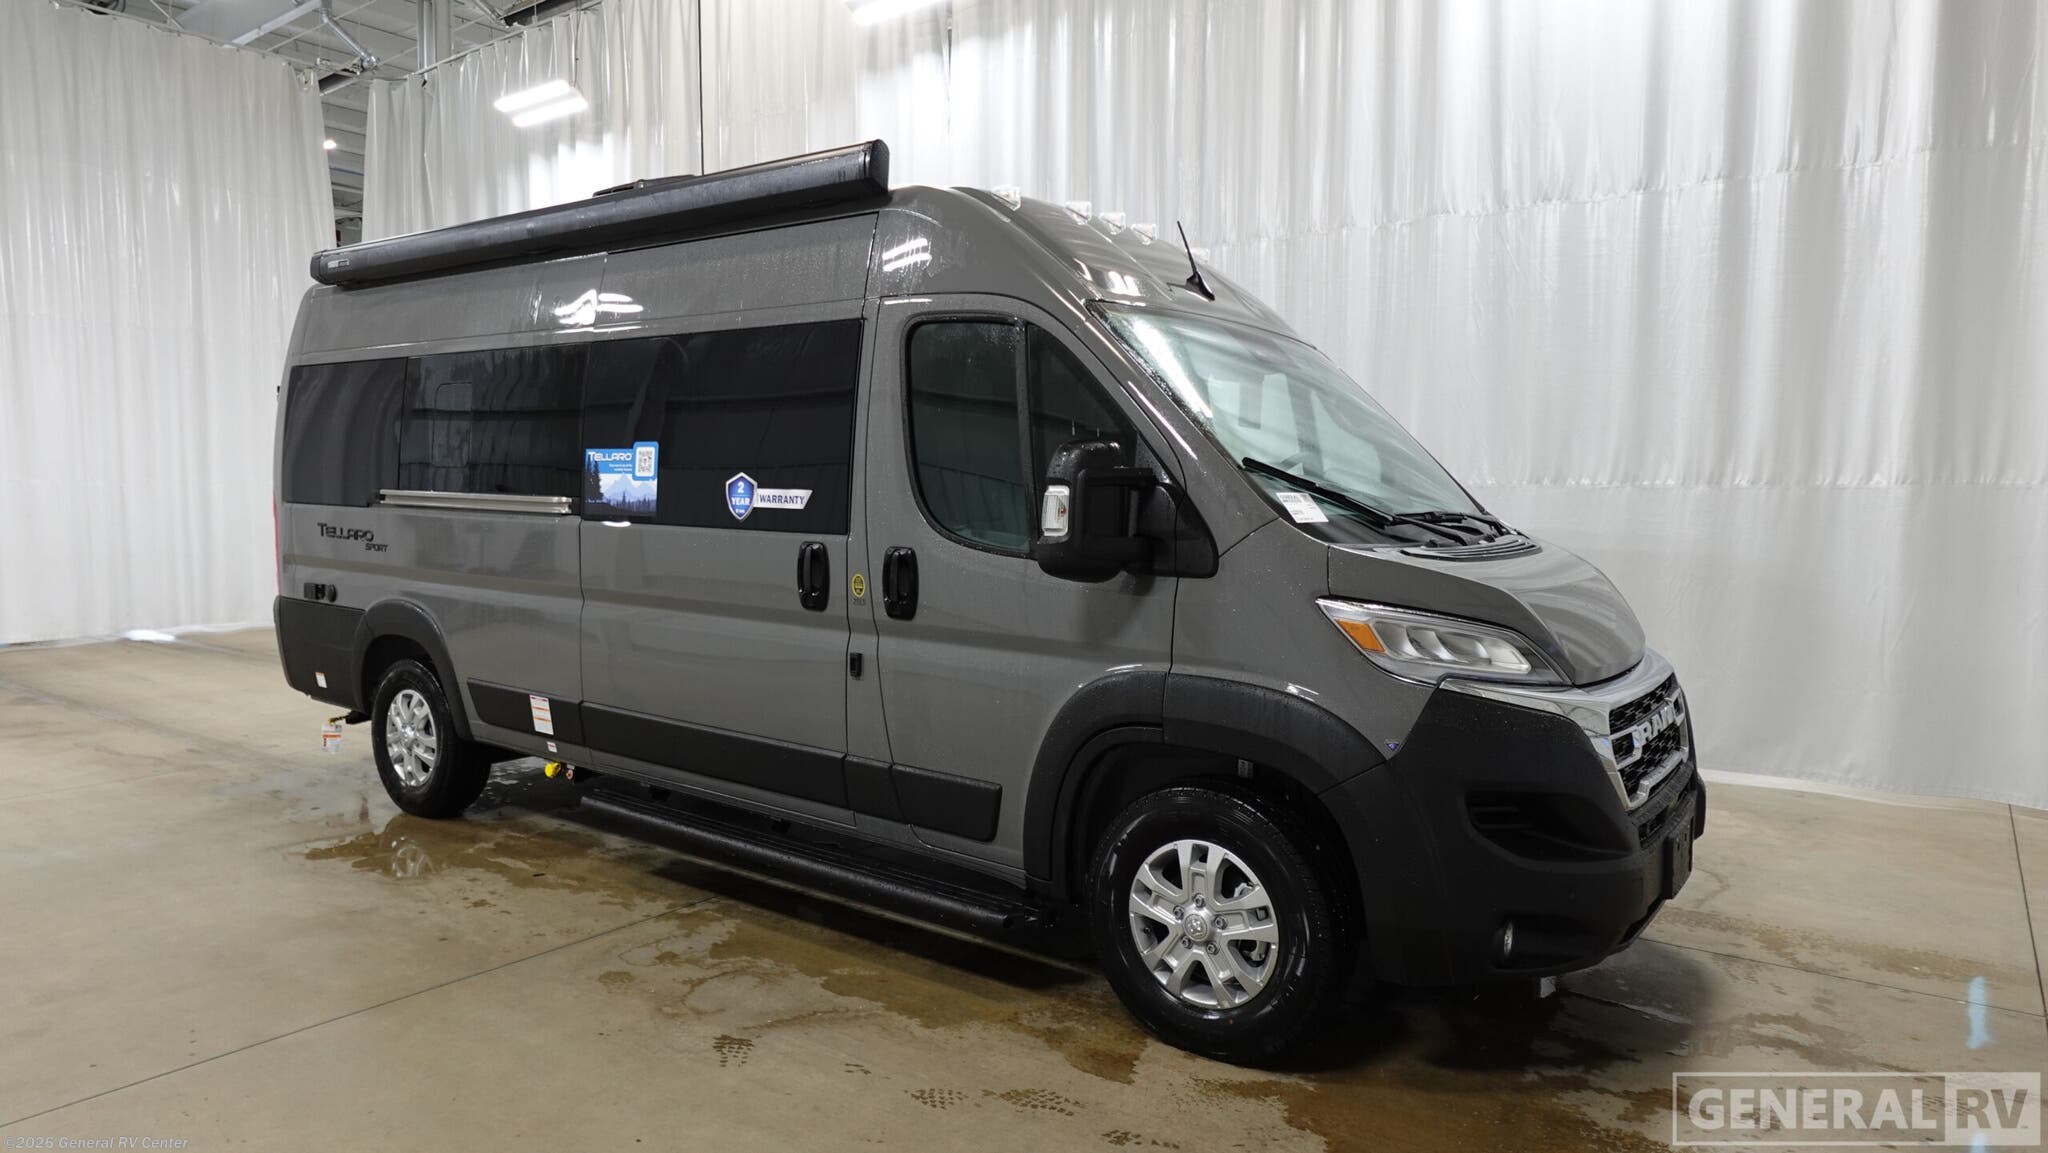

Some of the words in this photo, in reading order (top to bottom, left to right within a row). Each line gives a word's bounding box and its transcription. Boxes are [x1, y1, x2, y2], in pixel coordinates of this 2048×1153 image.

[588, 451, 632, 461] TELLARO
[737, 481, 745, 493] 2
[731, 497, 750, 506] YEAR
[759, 495, 805, 505] WARRANTY
[317, 522, 375, 542] TELLARO
[365, 543, 388, 552] SPORT
[1635, 701, 1676, 747] RAM
